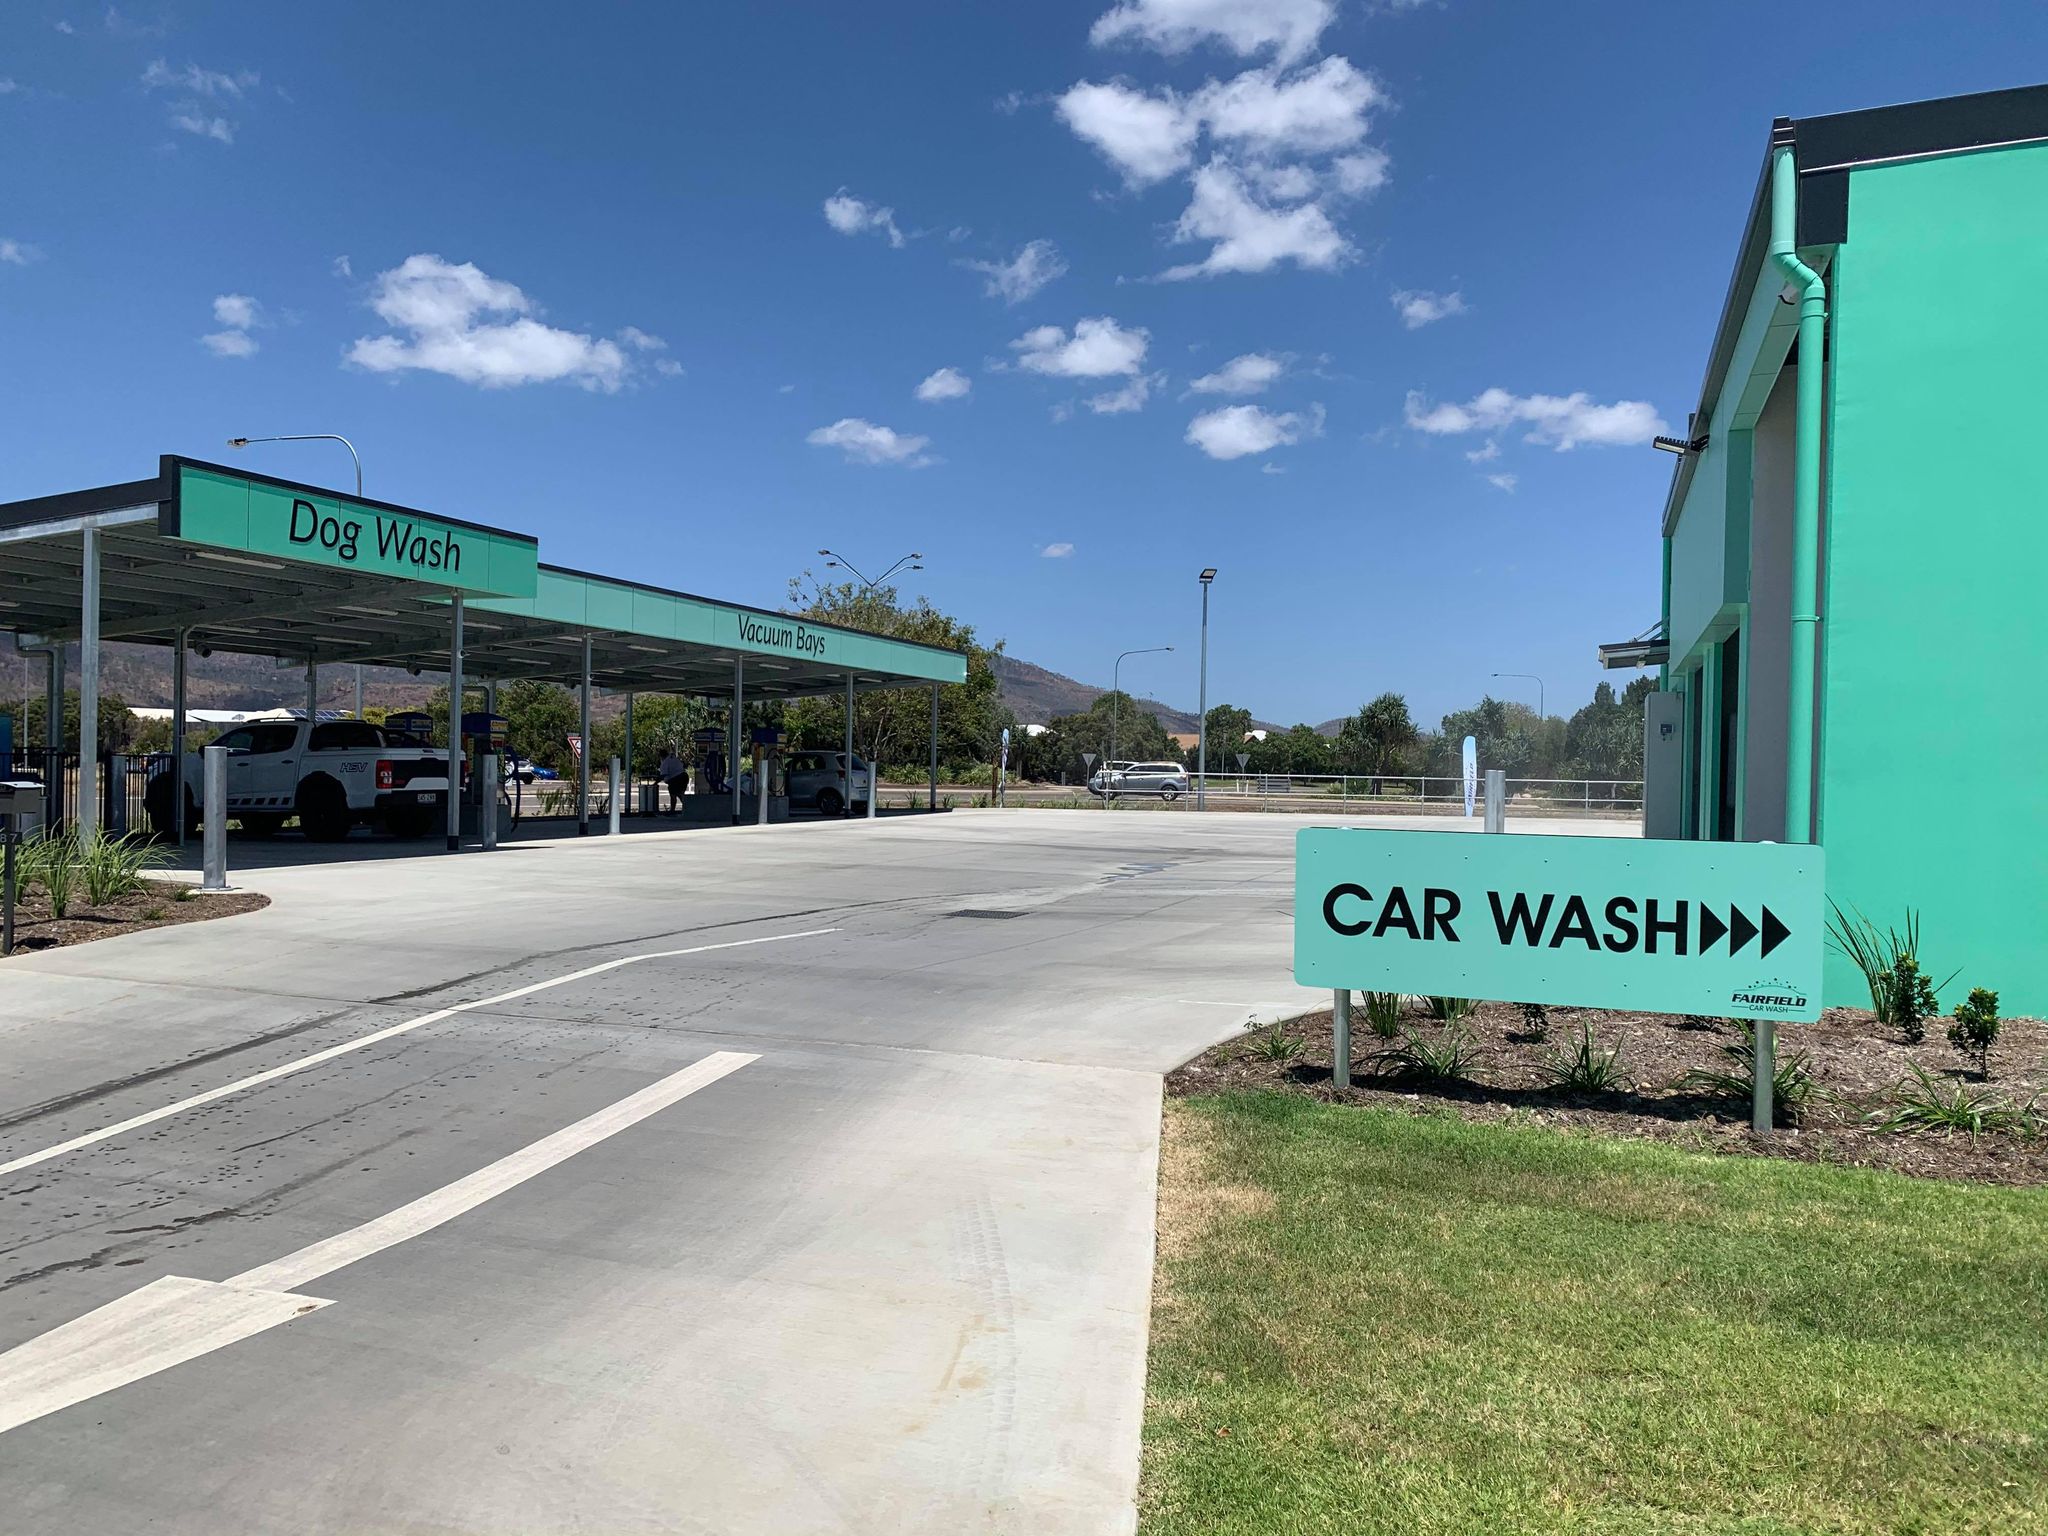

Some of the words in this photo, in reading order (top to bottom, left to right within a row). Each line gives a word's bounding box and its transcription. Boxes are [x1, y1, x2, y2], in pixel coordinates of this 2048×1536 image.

[289, 498, 362, 560] Dog
[376, 516, 460, 572] Wash
[738, 614, 793, 649] Vacuum
[796, 626, 825, 657] Bays
[340, 762, 368, 773] HSV
[1323, 883, 1461, 942] CAR
[1487, 891, 1688, 955] WASH
[1732, 994, 1807, 1006] FAIRFIELD
